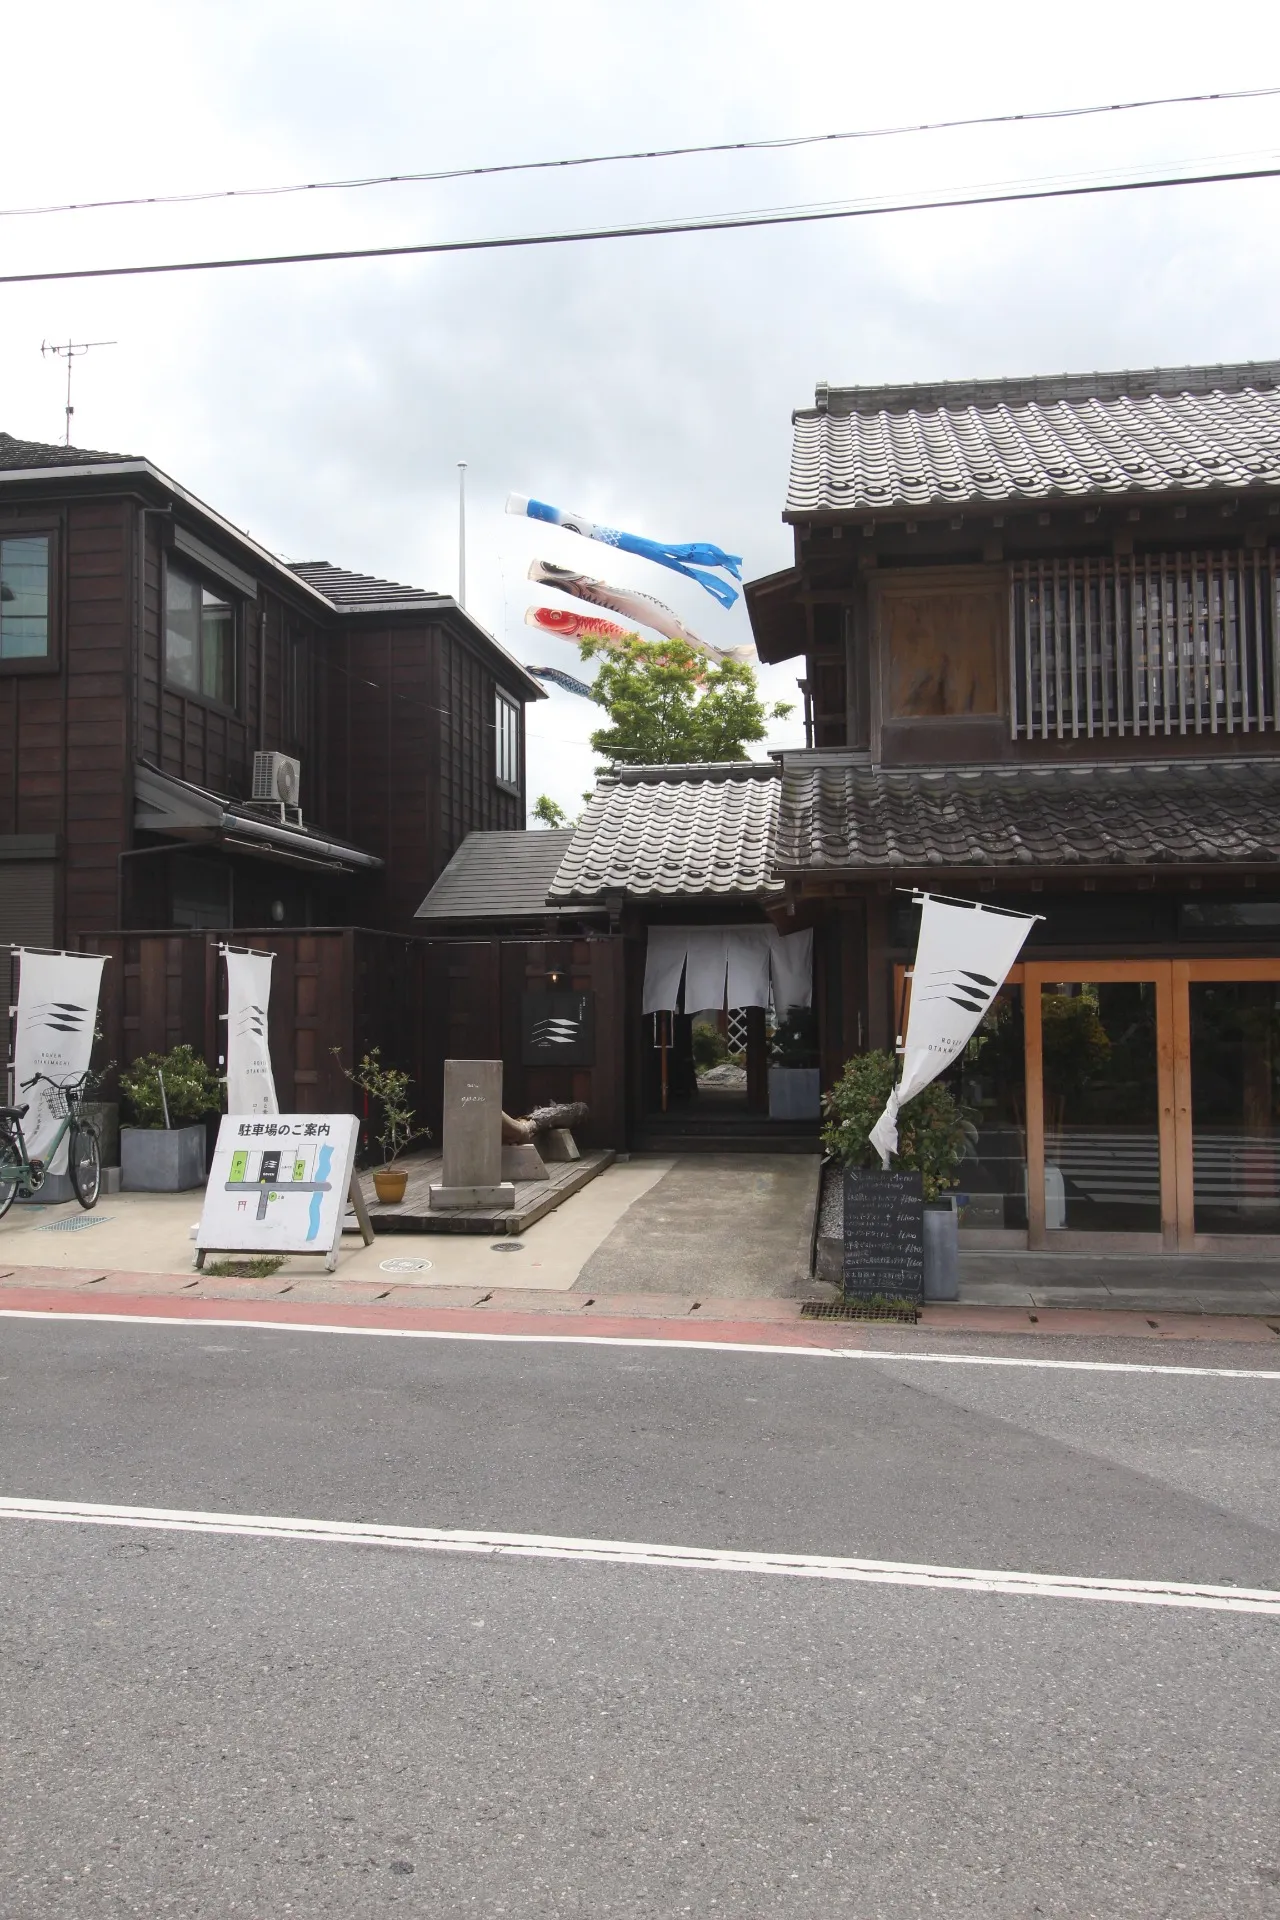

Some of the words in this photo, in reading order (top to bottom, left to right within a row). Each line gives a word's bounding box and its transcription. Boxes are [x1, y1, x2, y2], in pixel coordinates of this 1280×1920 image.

[238, 1123, 331, 1137] 駐車場のご案内
